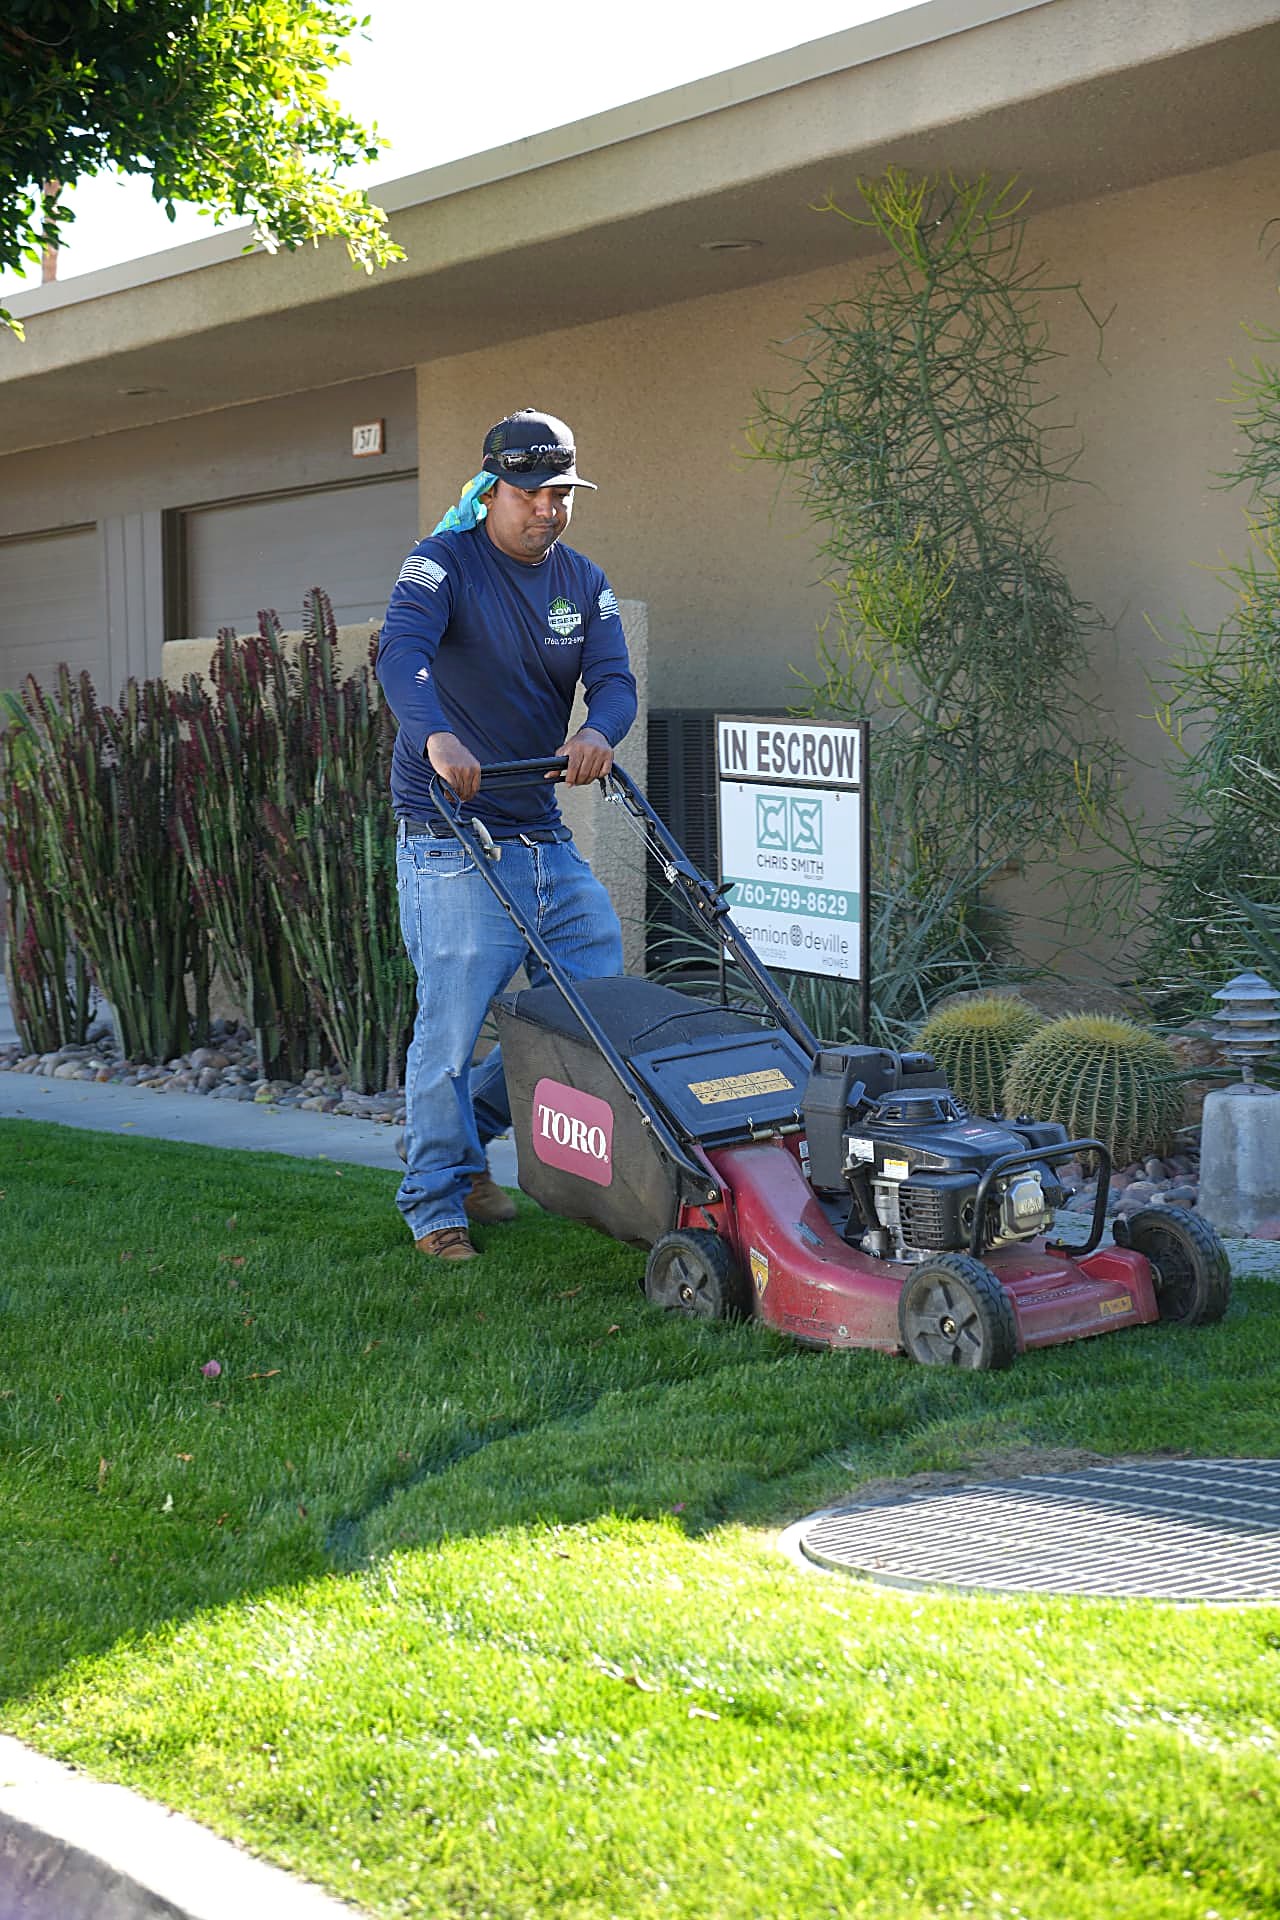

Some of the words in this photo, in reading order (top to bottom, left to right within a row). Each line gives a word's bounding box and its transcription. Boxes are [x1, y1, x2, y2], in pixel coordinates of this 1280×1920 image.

[550, 615, 580, 625] ESERT
[723, 728, 748, 771] IN
[756, 730, 856, 779] ESCROW
[756, 853, 788, 871] CHRIS
[791, 857, 825, 875] SMITH
[734, 882, 848, 917] 760-799-8629
[804, 930, 849, 954] deville
[822, 956, 849, 969] HOMES
[538, 1103, 607, 1160] TORO
